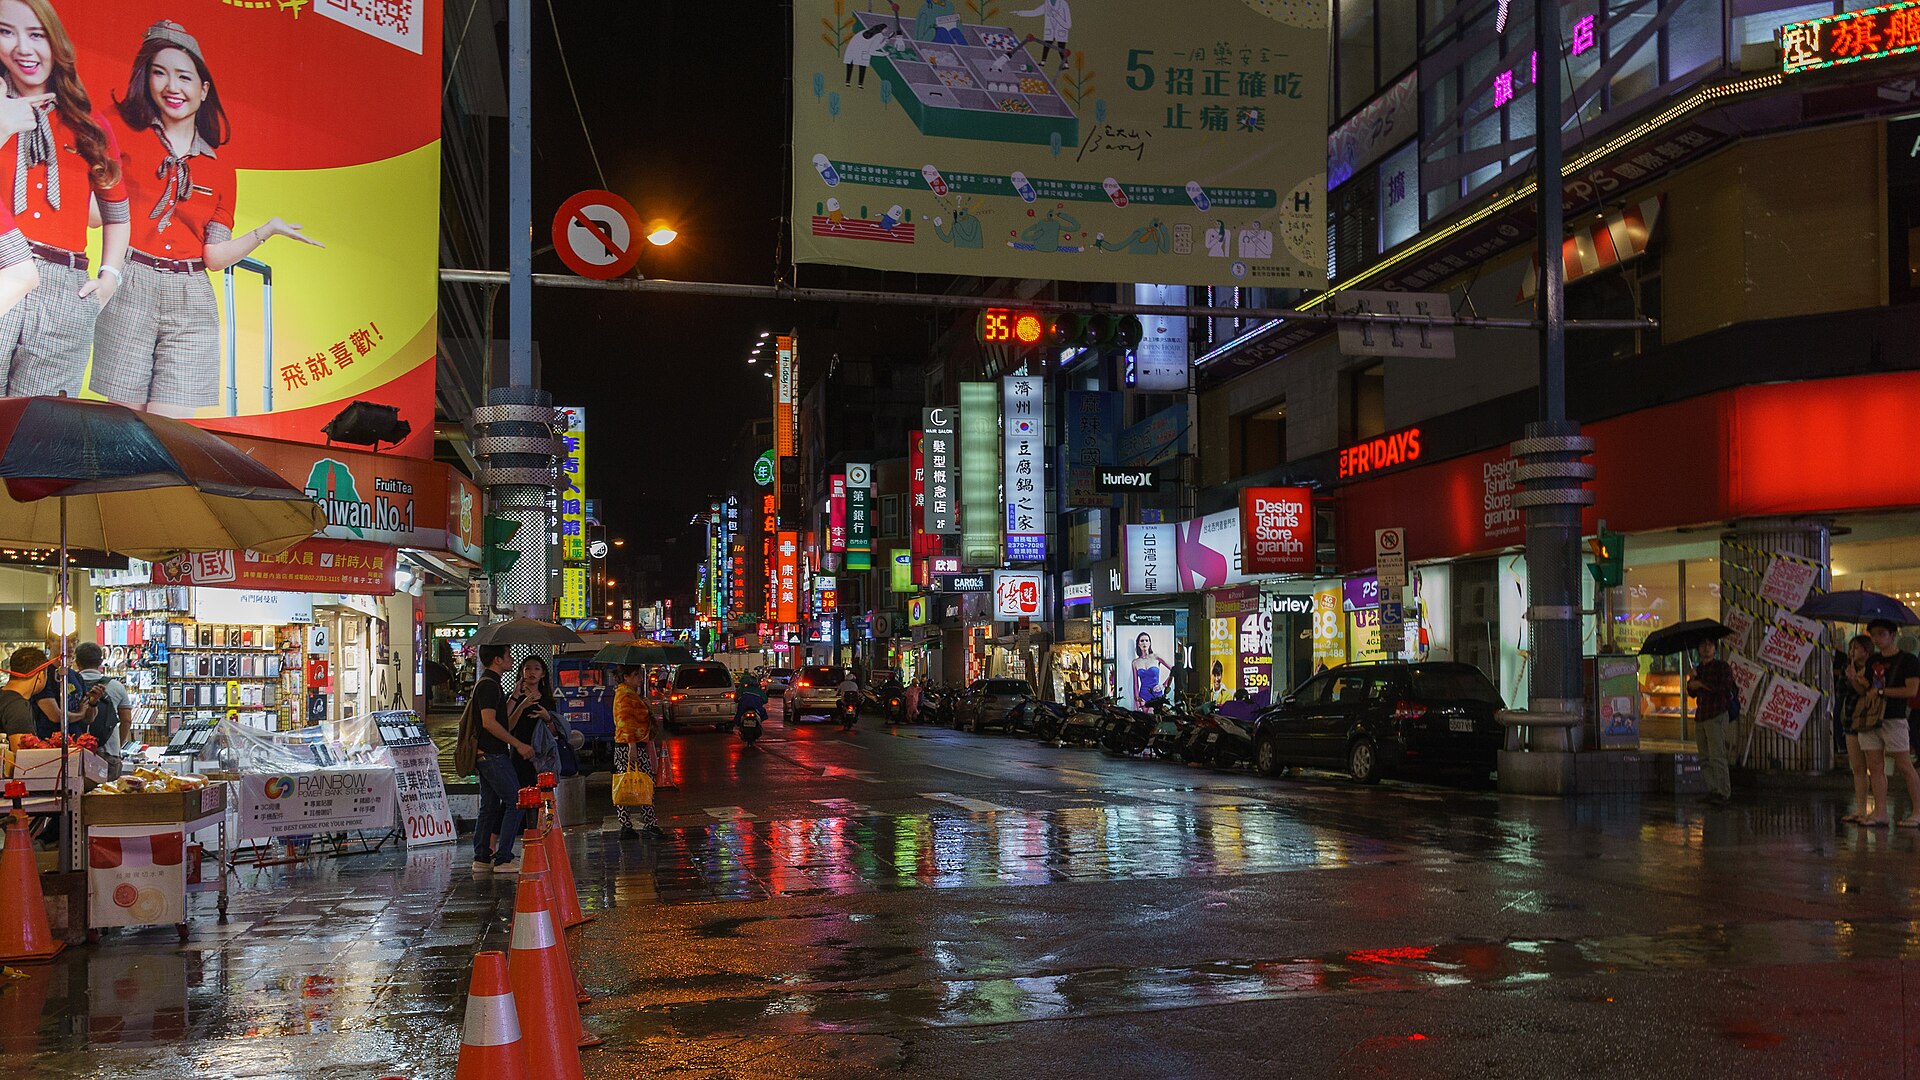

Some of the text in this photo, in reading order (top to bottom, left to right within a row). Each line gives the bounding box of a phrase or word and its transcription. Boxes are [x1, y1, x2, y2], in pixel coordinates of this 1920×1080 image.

[1126, 49, 1155, 91] 5
[1165, 66, 1303, 100] 招正確吃
[1163, 102, 1265, 133] 止痛藥
[986, 314, 1009, 341] 35
[280, 321, 386, 391] 飛就喜歡!
[1348, 428, 1421, 477] FRIDAYS
[375, 478, 413, 494] Fruit Tea
[933, 440, 946, 513] 髮型概念店
[1102, 473, 1140, 486] Hurley
[375, 496, 414, 532] No.1
[853, 490, 865, 534] 第一銀行
[1255, 499, 1303, 518] Design
[1255, 513, 1298, 528] Tshirts
[1256, 527, 1292, 541] Store
[1256, 539, 1303, 557] graniph
[334, 553, 384, 571] 計時人員
[782, 564, 793, 604] 康是美
[1362, 580, 1378, 598] PS
[1242, 612, 1272, 634] 4G
[1771, 693, 1804, 713] Tshirts
[1774, 685, 1811, 706] Design
[1765, 701, 1794, 719] Store
[1761, 711, 1799, 731] graniph
[298, 773, 367, 791] RAINBOW
[298, 790, 323, 798] POWER
[345, 788, 367, 796] STORE
[346, 819, 363, 827] PHONE
